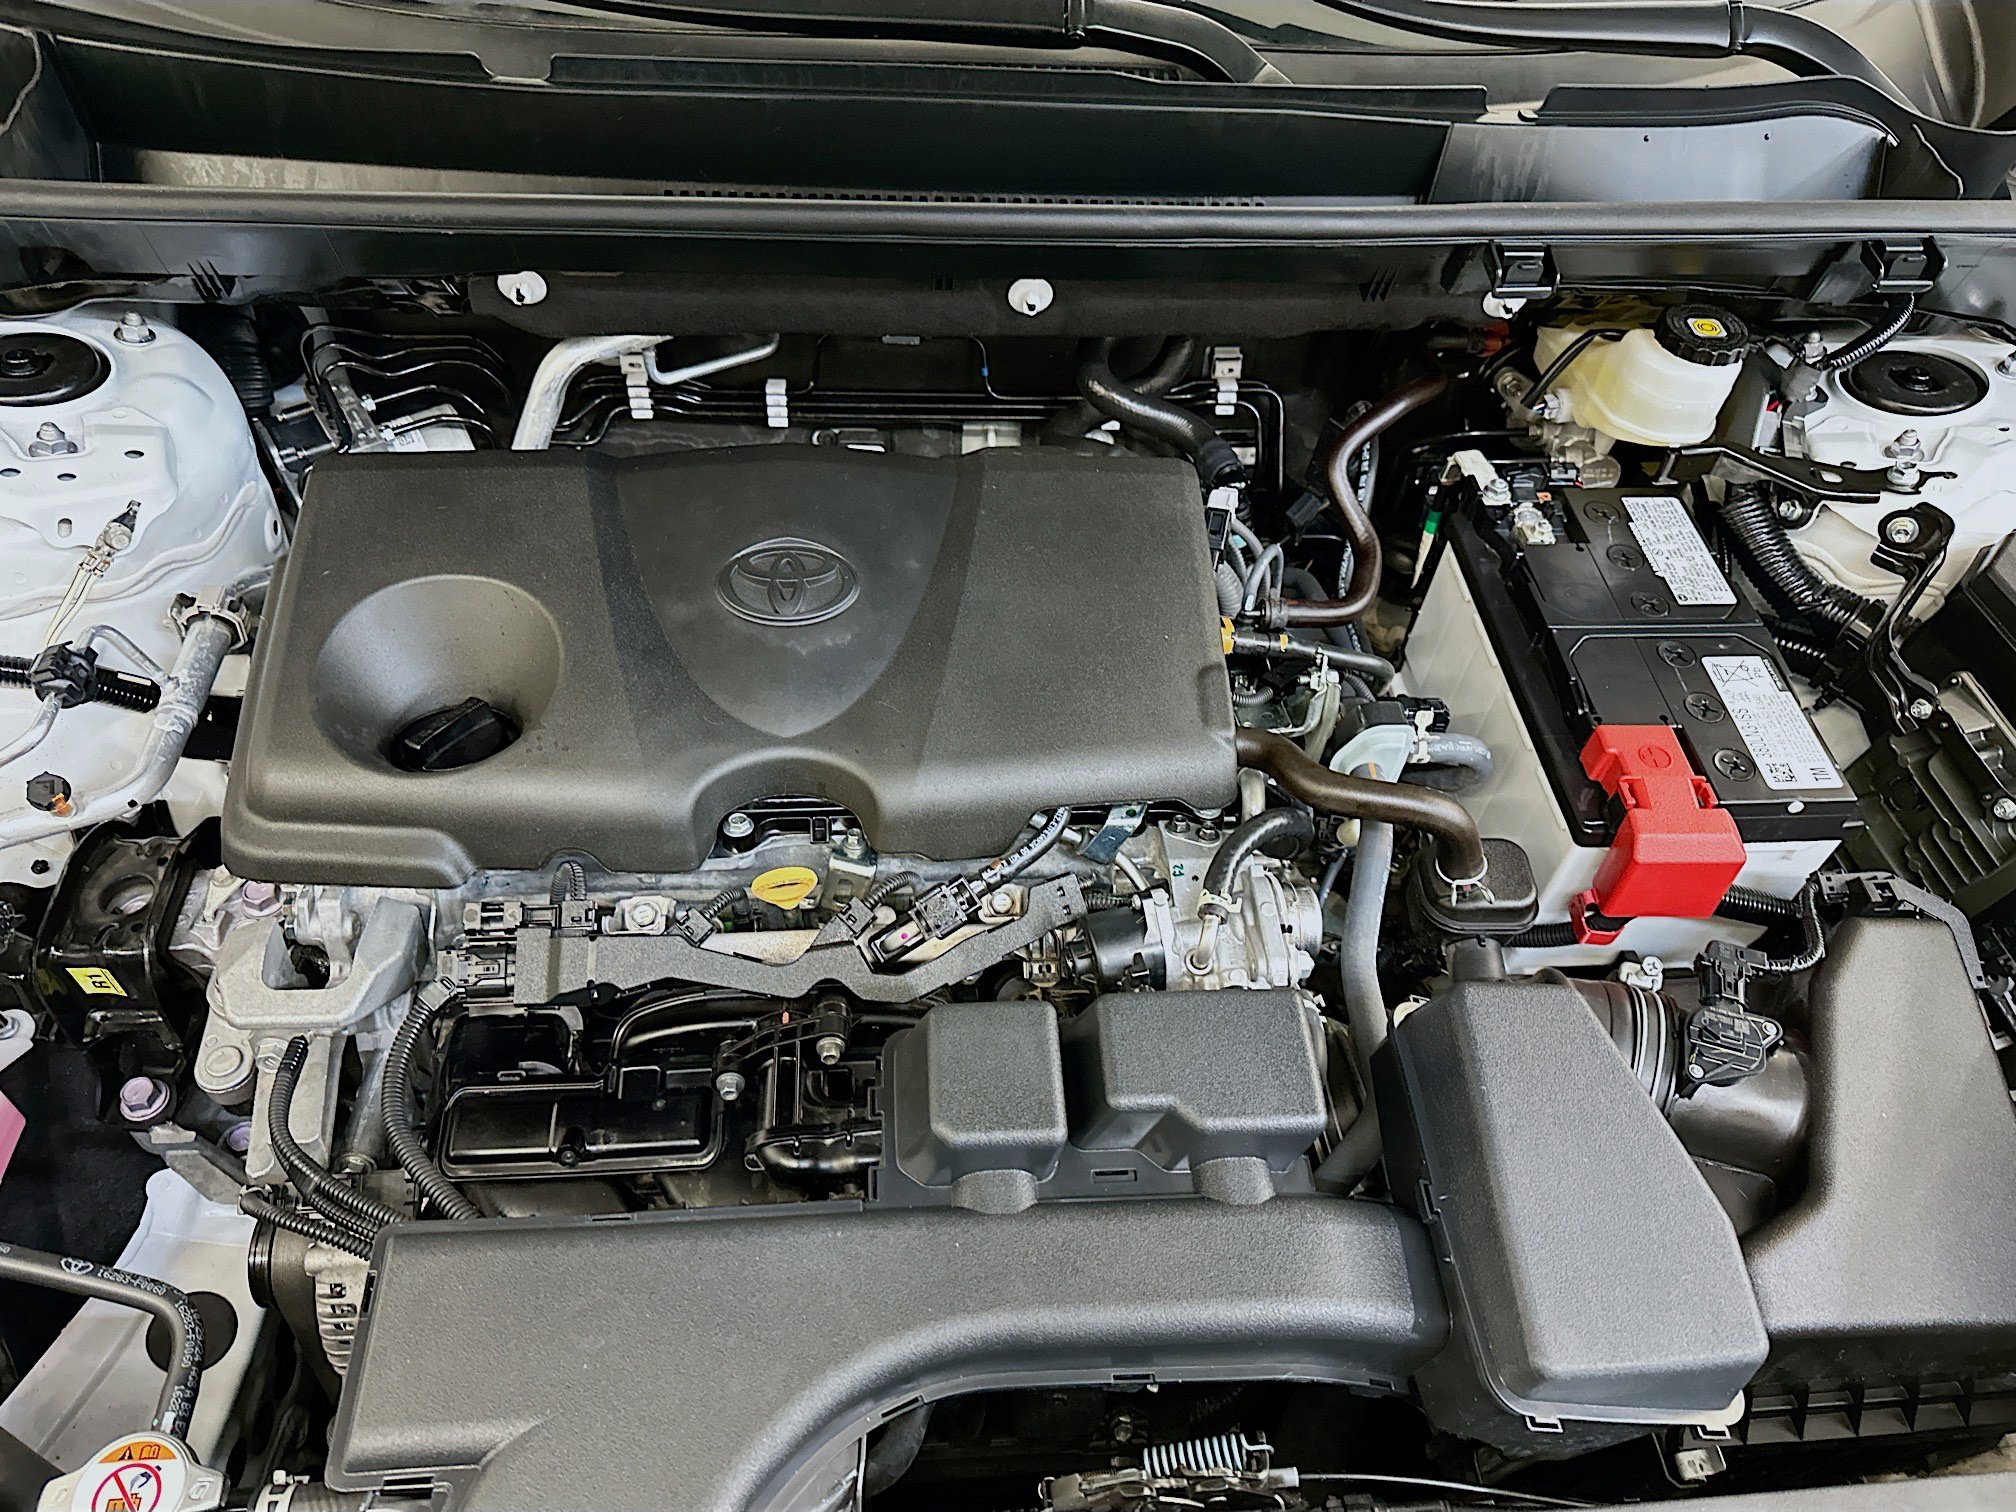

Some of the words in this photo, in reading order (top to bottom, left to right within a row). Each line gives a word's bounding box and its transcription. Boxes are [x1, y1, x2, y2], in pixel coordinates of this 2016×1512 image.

[1753, 667, 1764, 678] Pb
[1732, 708, 1773, 758] 380LN3-ISS
[1809, 767, 1832, 782] TM
[87, 974, 111, 989] R1
[174, 1300, 195, 1368] 16283-F0060
